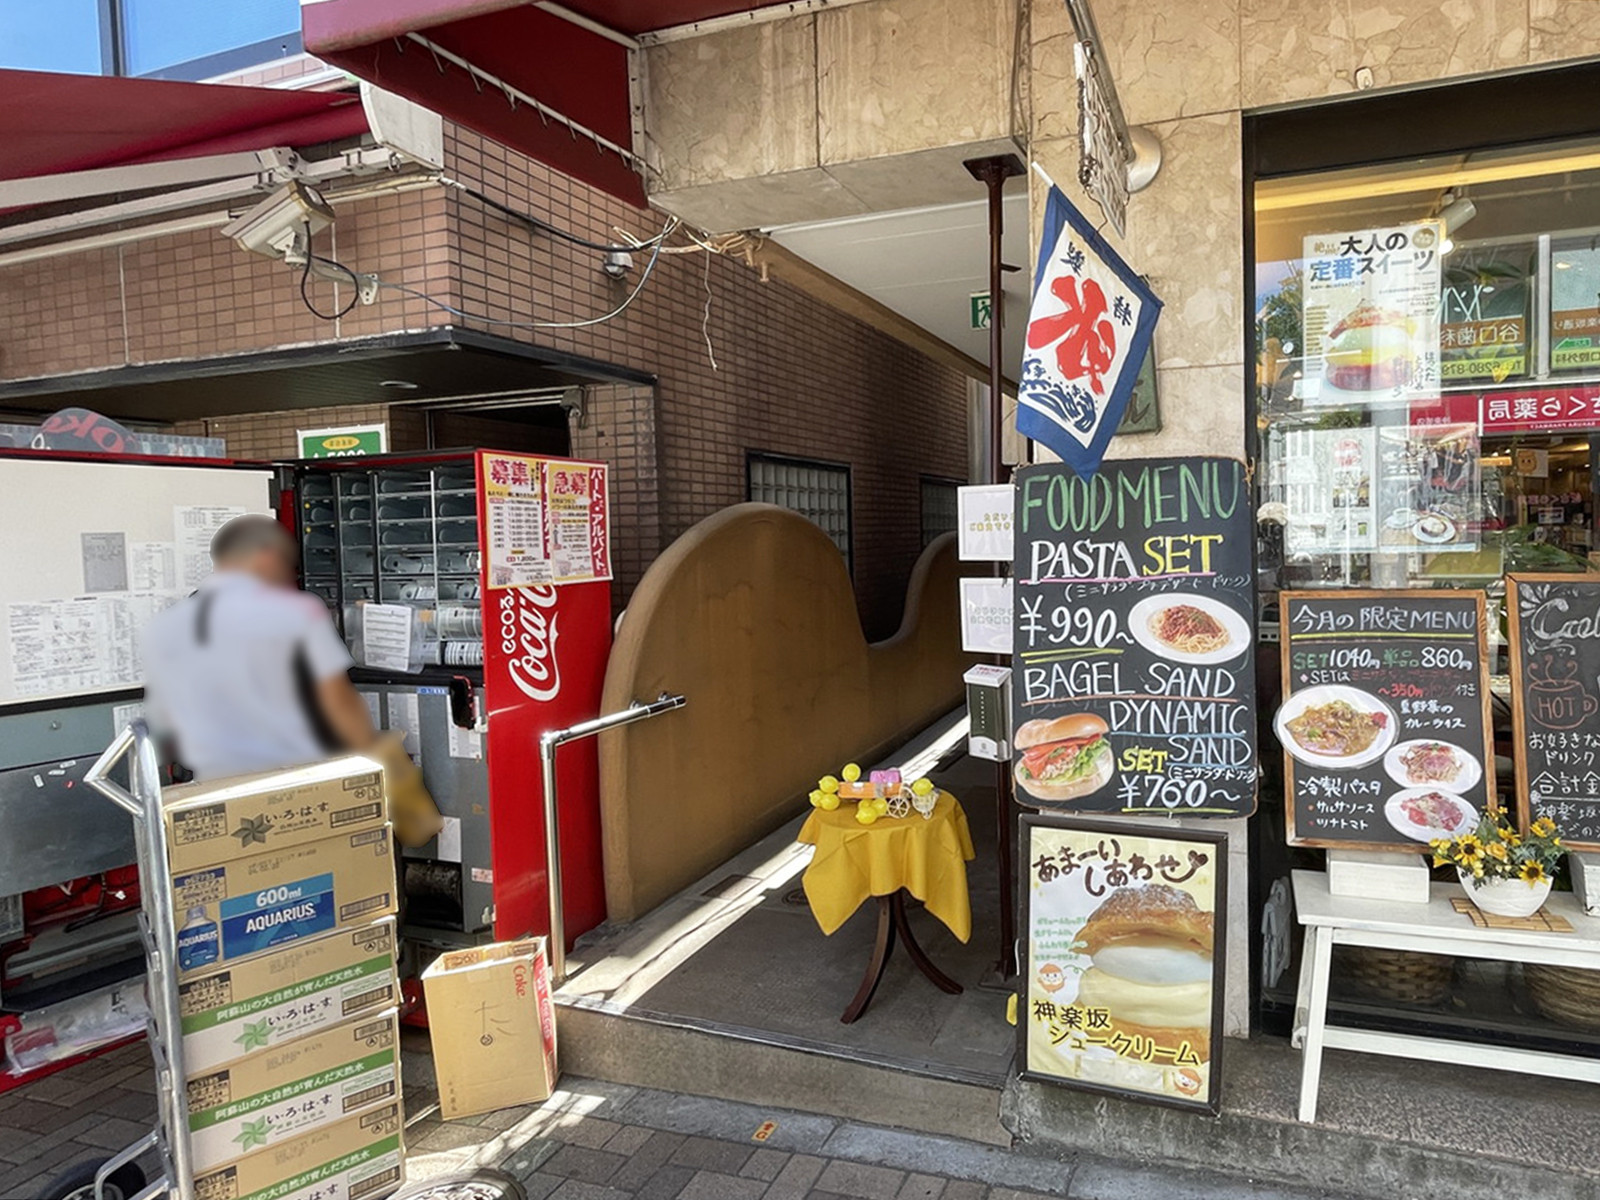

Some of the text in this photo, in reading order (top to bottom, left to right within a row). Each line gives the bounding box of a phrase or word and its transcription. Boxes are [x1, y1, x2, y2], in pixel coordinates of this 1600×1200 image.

[1340, 232, 1409, 256] 大人の
[1310, 250, 1434, 282] 定番スイーツ
[489, 459, 529, 486] 募集
[553, 471, 587, 495] 急募
[1023, 461, 1239, 533] FOOD MENU
[1030, 534, 1223, 585] PASTA SET
[508, 584, 560, 702] Coca-C
[1024, 661, 1236, 702] BAGEL SAND
[1109, 699, 1249, 735] DYNAMIC
[1400, 700, 1454, 715] 夏野菜の
[1538, 695, 1576, 719] HOT
[1404, 717, 1466, 729] カレーライス
[1118, 745, 1168, 774] SET
[1168, 736, 1251, 765] SAND
[1545, 750, 1595, 766] ドリンク
[1298, 776, 1382, 798] 冷製パスタ
[1316, 800, 1375, 815] サルサソース
[1316, 818, 1369, 831] ツナトマト
[1084, 852, 1205, 897] しあわせ
[245, 902, 316, 934] AQUARIUS
[512, 964, 526, 997] Coke
[1034, 1000, 1110, 1030] 神楽坂
[1049, 1025, 1200, 1066] シュークリーム
